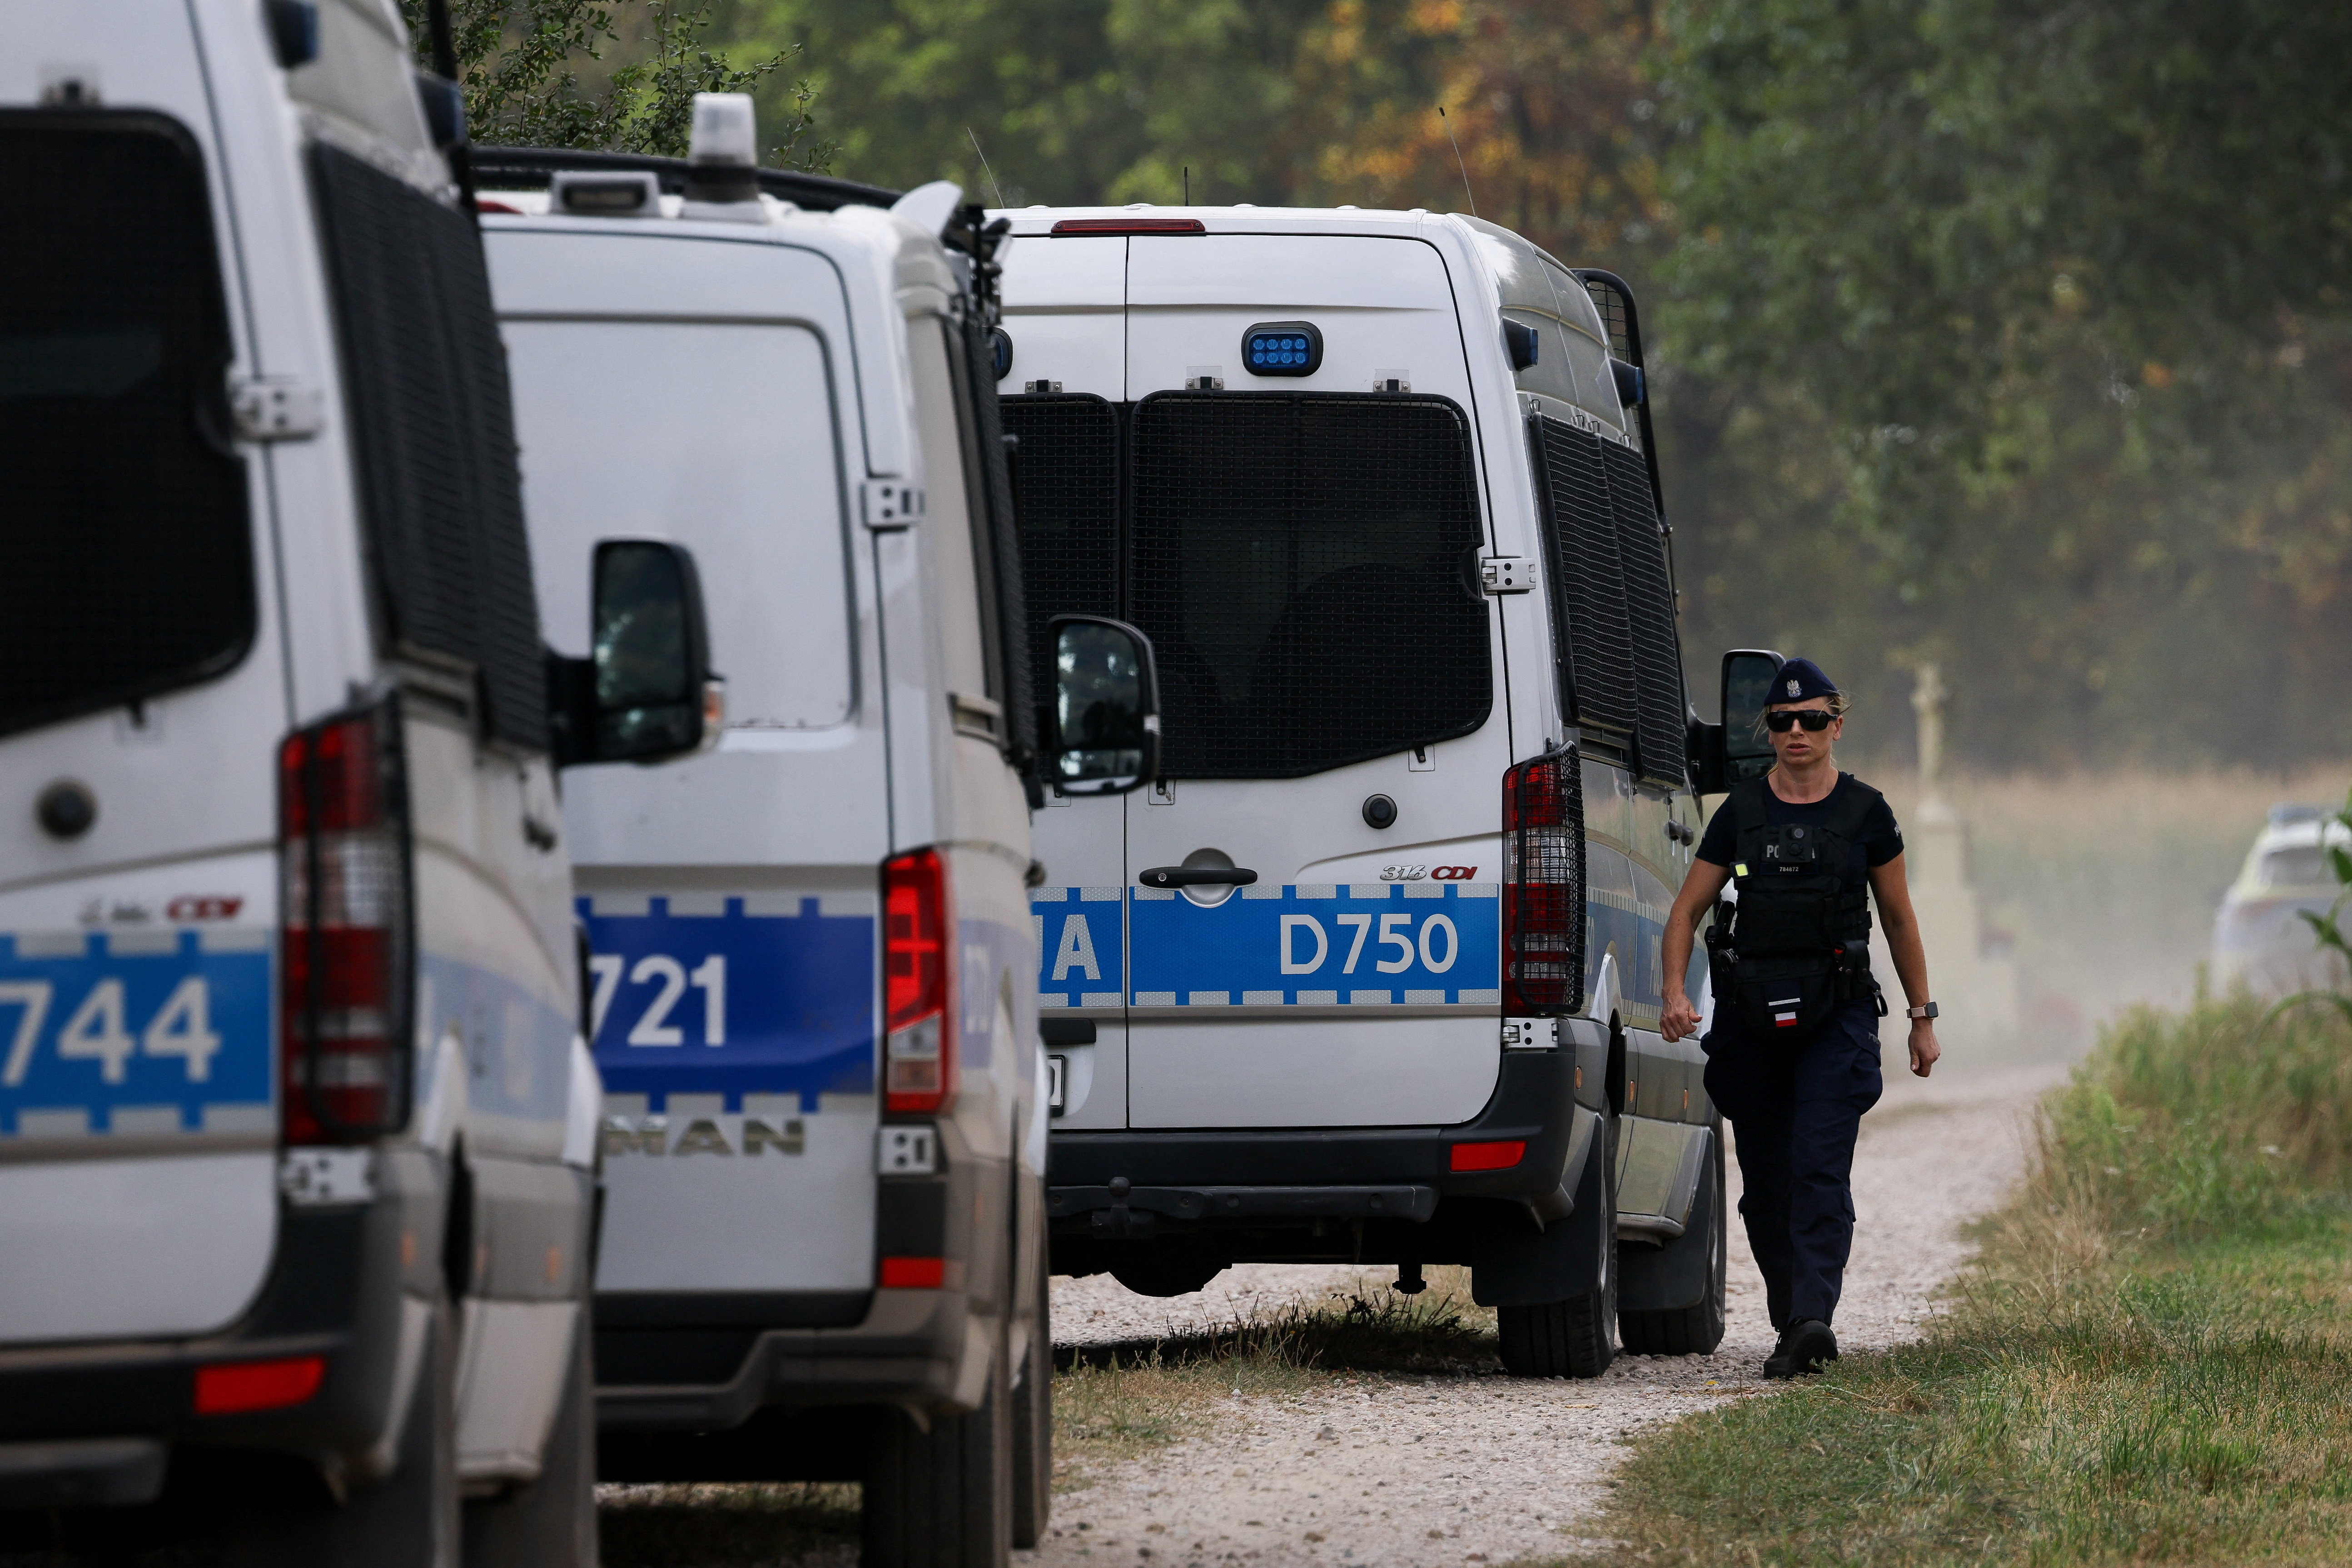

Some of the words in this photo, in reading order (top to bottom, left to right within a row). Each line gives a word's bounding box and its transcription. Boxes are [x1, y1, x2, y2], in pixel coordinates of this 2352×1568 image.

[1380, 865, 1427, 880] 316
[1431, 866, 1478, 880] CDI
[1280, 913, 1457, 975] D750
[0, 977, 222, 1085] 744
[588, 954, 725, 1046] 721
[603, 1116, 806, 1156] MAN
